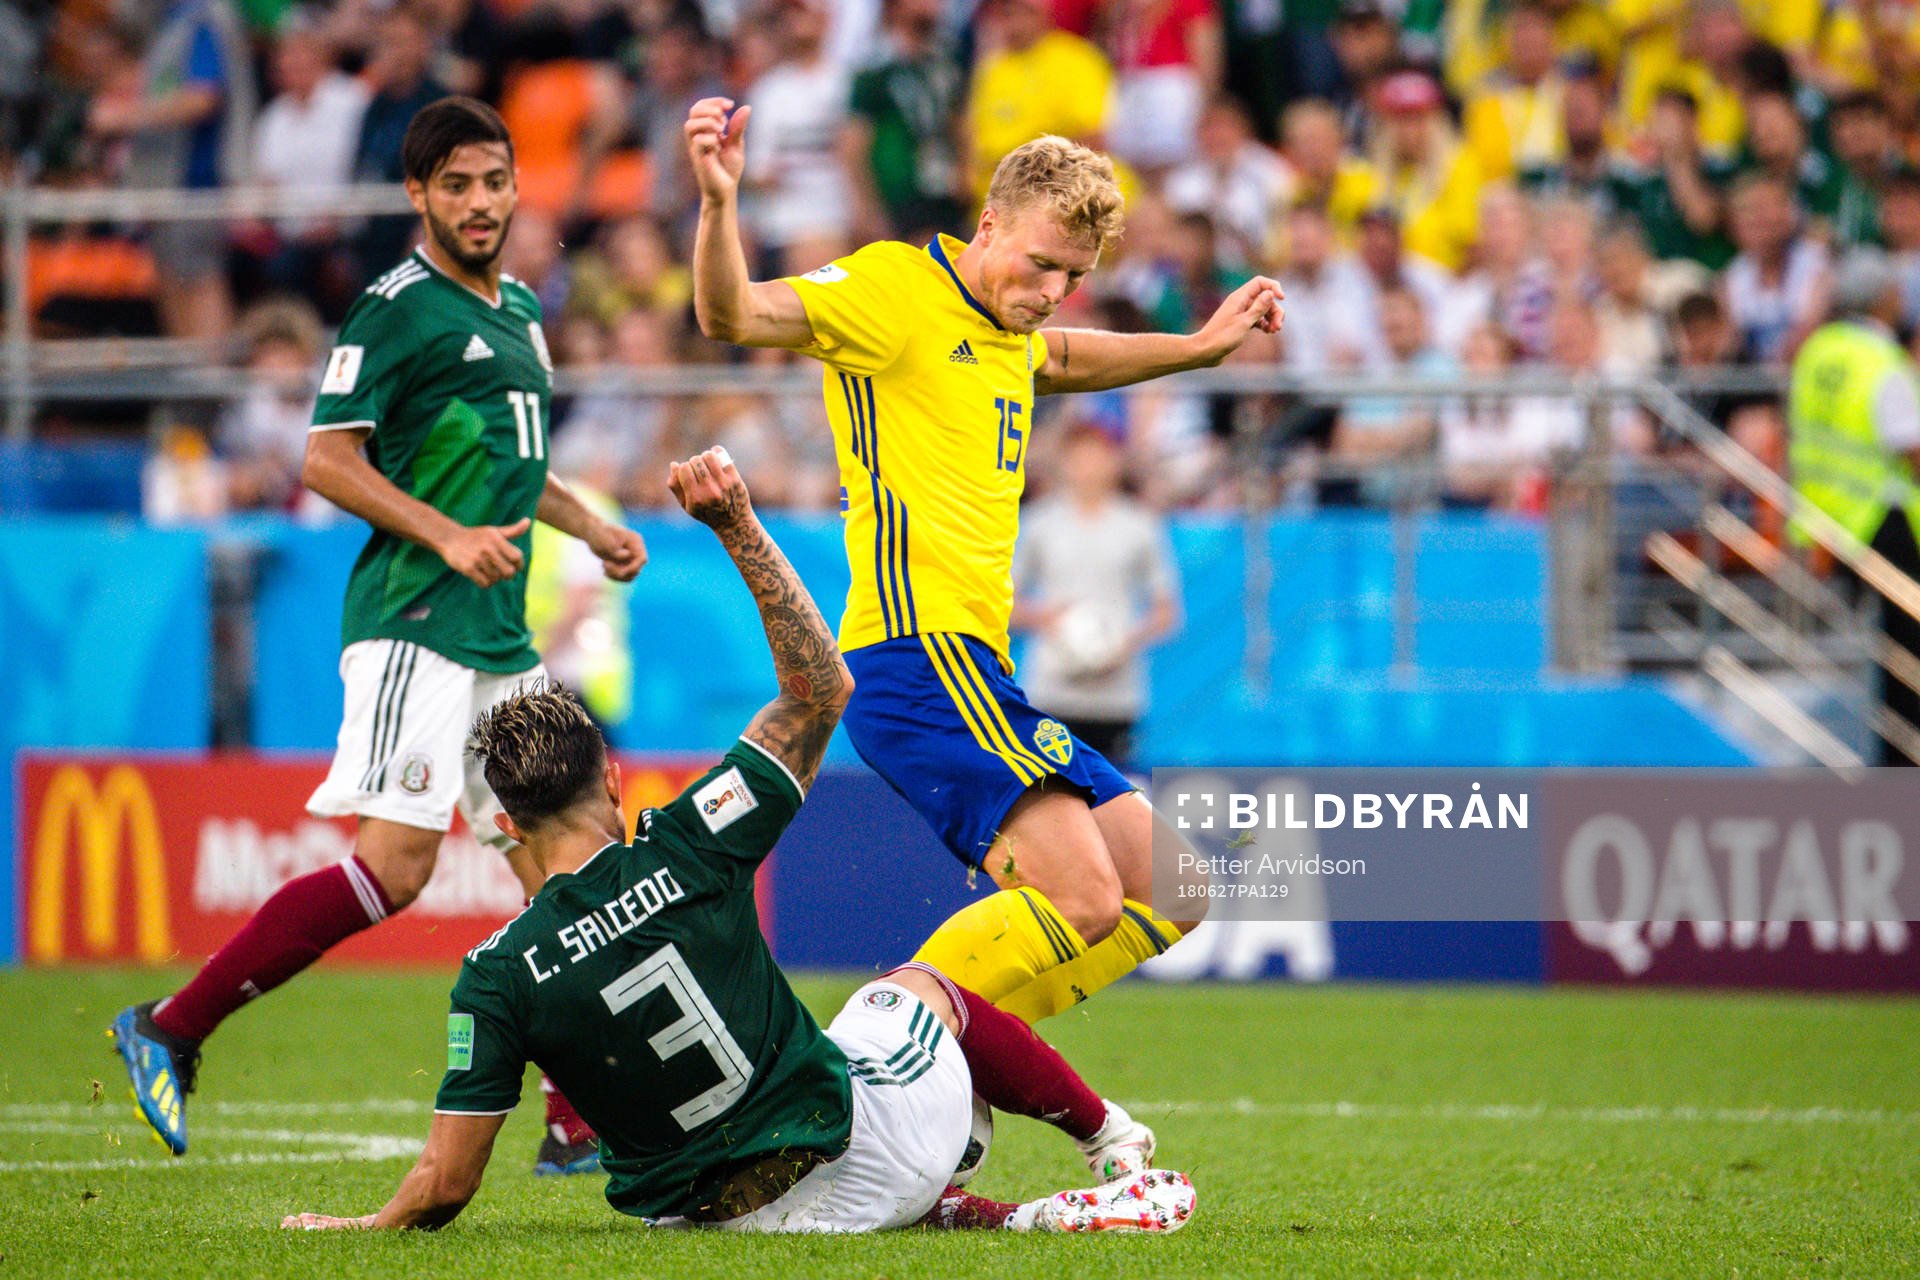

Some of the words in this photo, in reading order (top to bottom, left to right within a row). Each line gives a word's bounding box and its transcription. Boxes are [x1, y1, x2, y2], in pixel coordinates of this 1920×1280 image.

[949, 354, 978, 365] adidas
[507, 391, 544, 460] 11
[995, 397, 1022, 473] 15
[523, 945, 560, 984] C.
[557, 867, 685, 963] SALCEDO
[1561, 814, 1910, 977] QATAR
[600, 942, 755, 1132] 3
